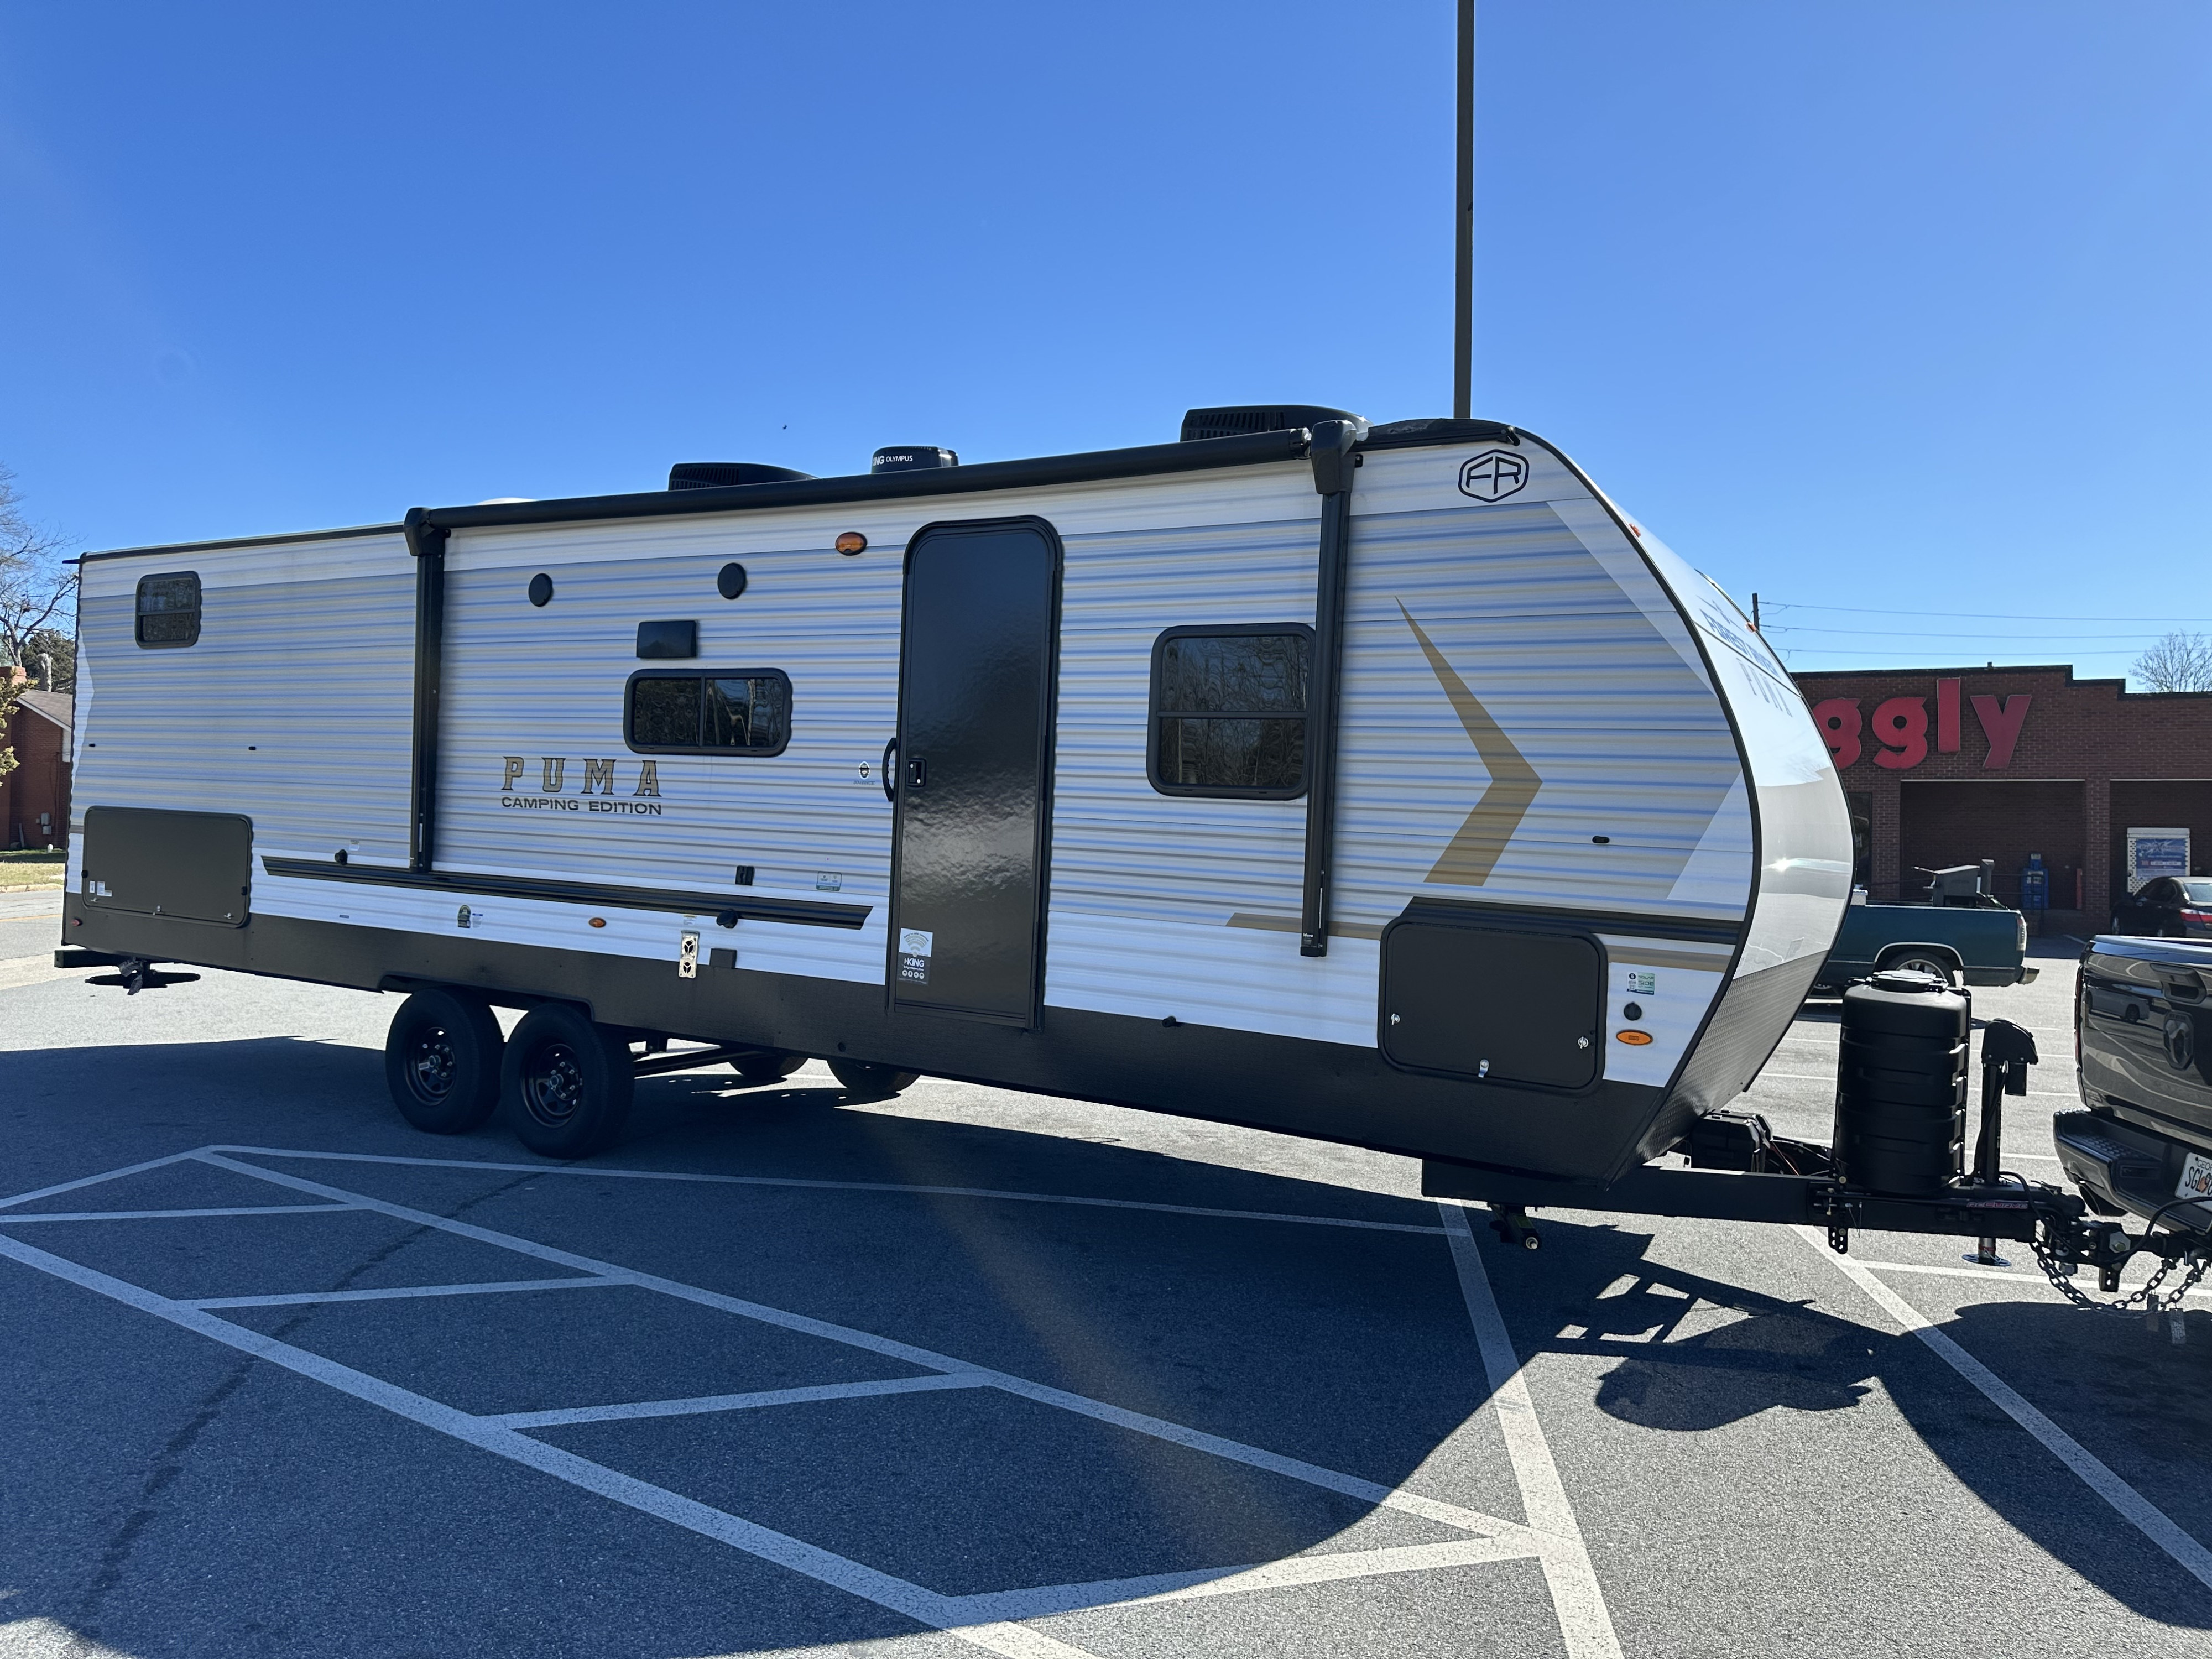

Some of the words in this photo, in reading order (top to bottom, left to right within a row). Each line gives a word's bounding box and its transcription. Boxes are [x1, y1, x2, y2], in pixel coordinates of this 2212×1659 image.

[1699, 608, 1752, 658] FOREST
[1812, 676, 2032, 769] ggly
[501, 756, 662, 797] PUMA
[502, 797, 579, 811] CAMPING
[589, 801, 662, 815] EDITION
[907, 958, 925, 967] KING
